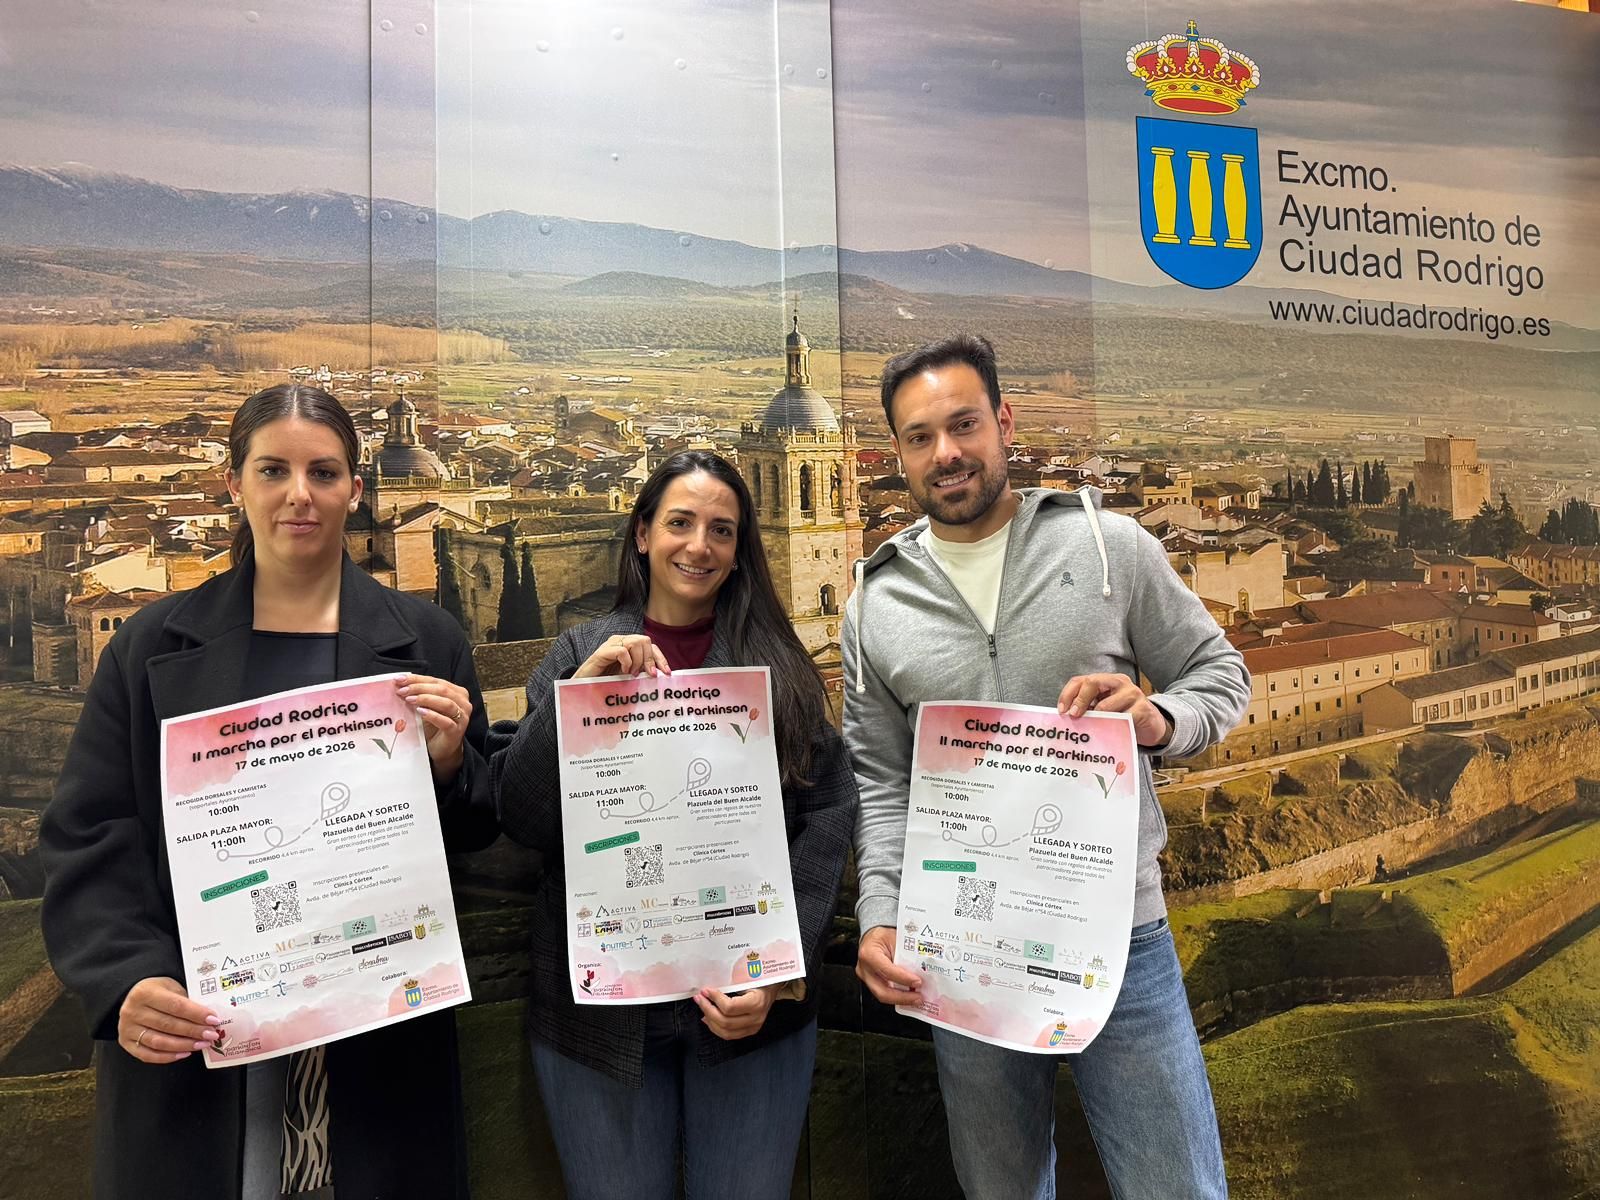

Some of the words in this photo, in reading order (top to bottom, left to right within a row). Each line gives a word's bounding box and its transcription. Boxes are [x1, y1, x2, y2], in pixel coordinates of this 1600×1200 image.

[1277, 150, 1398, 193] Excmo.
[1278, 194, 1496, 244] Ayuntamiento
[1504, 215, 1541, 247] de
[1279, 239, 1402, 279] Ciudad
[1417, 249, 1545, 296] Rodrigo
[1268, 299, 1551, 339] www.ciudadrodrigo.es
[605, 689, 659, 706] Ciudad
[664, 687, 720, 700] Rodrigo
[220, 712, 282, 736] Ciudad
[289, 702, 358, 722] Rodrigo
[583, 717, 590, 727] II
[595, 712, 644, 725] marcha
[648, 709, 670, 721] por
[674, 707, 684, 716] el
[687, 704, 748, 716] Parkinson
[192, 752, 201, 762] II
[206, 739, 265, 759] marcha
[270, 734, 296, 748] por
[302, 729, 313, 740] el
[318, 717, 392, 737] Parkinson
[620, 731, 629, 739] 17
[632, 728, 644, 738] de
[647, 725, 676, 735] mayo
[679, 724, 691, 732] de
[693, 722, 717, 731] 2026
[965, 719, 1021, 735] Ciudad
[1025, 725, 1090, 744] Rodrigo
[235, 761, 247, 770] 17
[251, 758, 266, 767] de
[269, 751, 304, 763] mayo
[308, 747, 322, 757] de
[326, 741, 356, 754] 2026
[940, 736, 947, 745] II
[951, 738, 1002, 752] marcha
[1005, 745, 1029, 755] por
[1033, 747, 1043, 756] el
[1047, 748, 1115, 764] Parkinson
[596, 769, 621, 778] 10:00h
[974, 758, 984, 766] 17
[987, 760, 998, 768] de
[1002, 762, 1031, 772] mayo
[1035, 765, 1047, 774] de
[1050, 767, 1078, 778] 2026
[176, 796, 203, 806] RECOGIDA
[205, 790, 232, 800] DORSALES
[237, 784, 267, 794] CAMISETAS
[569, 791, 594, 799] SALIDA
[596, 787, 618, 796] PLAZA
[620, 785, 647, 793] MAYOR:
[690, 788, 722, 797] LLEGADA
[730, 785, 758, 794] SORTEO
[945, 792, 969, 801] 10:00h
[208, 804, 239, 817] 10:00h
[596, 798, 624, 807] 11:00h
[325, 811, 366, 827] LLEGADA
[375, 802, 410, 815] SORTEO
[916, 806, 940, 815] SALIDA
[942, 810, 963, 818] PLAZA
[965, 814, 991, 823] MAYOR:
[176, 831, 208, 844] SALIDA
[210, 824, 238, 837] PLAZA
[239, 818, 273, 831] MAYOR:
[322, 825, 354, 838] Plazuela
[368, 819, 386, 828] Buen
[388, 813, 414, 824] Alcalde
[940, 821, 967, 831] 11:00h
[211, 835, 246, 849] 11:00h
[588, 834, 638, 850] INSCRIPCIONES
[1033, 836, 1070, 848] LLEGADA
[1080, 843, 1112, 854] SORTEO
[248, 853, 280, 865] RECORRIDO
[964, 848, 990, 856] RECORRIDO
[1028, 847, 1056, 857] Plazuela
[1070, 853, 1087, 861] Buen
[1089, 856, 1113, 865] Alcalde
[925, 862, 974, 870] INSCRIPCIONES
[203, 873, 266, 899] INSCRIPCIONES
[611, 906, 636, 914] ACTIVA
[935, 932, 960, 940] ACTIVA
[240, 951, 270, 963] ACTIVA
[381, 970, 408, 981] Colabora:
